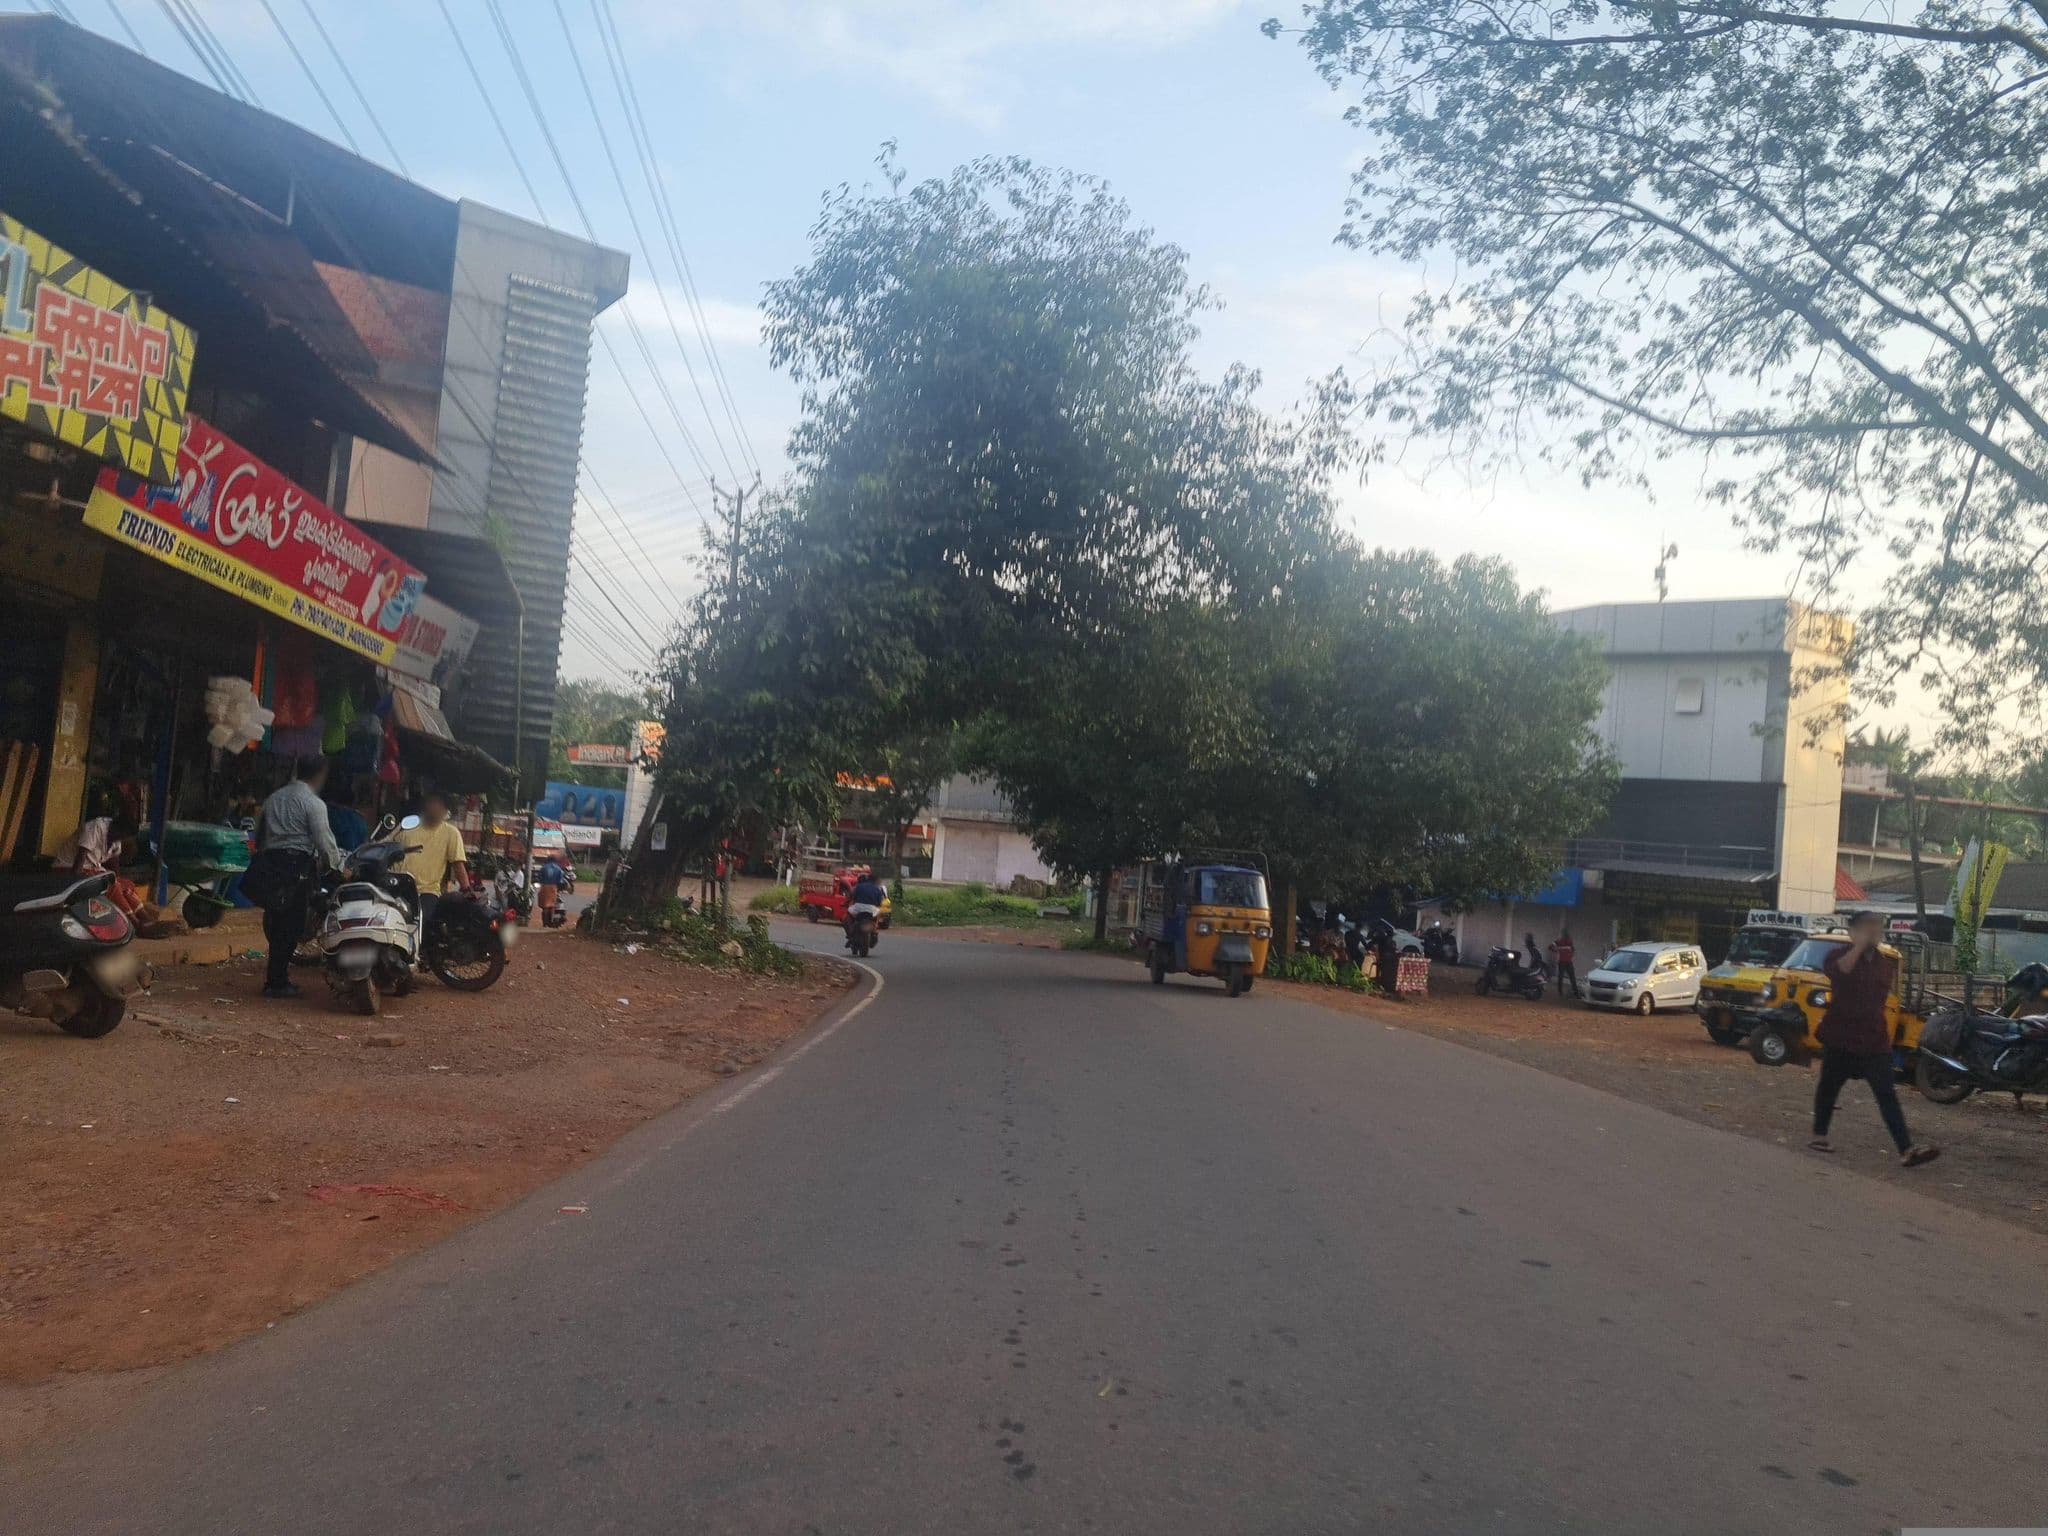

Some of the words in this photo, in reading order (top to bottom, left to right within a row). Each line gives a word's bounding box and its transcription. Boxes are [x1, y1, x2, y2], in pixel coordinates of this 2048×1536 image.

[34, 283, 168, 379] GRAND
[0, 333, 142, 422] PLAZA
[116, 509, 177, 554] FRIENDS
[175, 542, 230, 579] ELECTRICALS
[235, 571, 273, 600] PLUMBING
